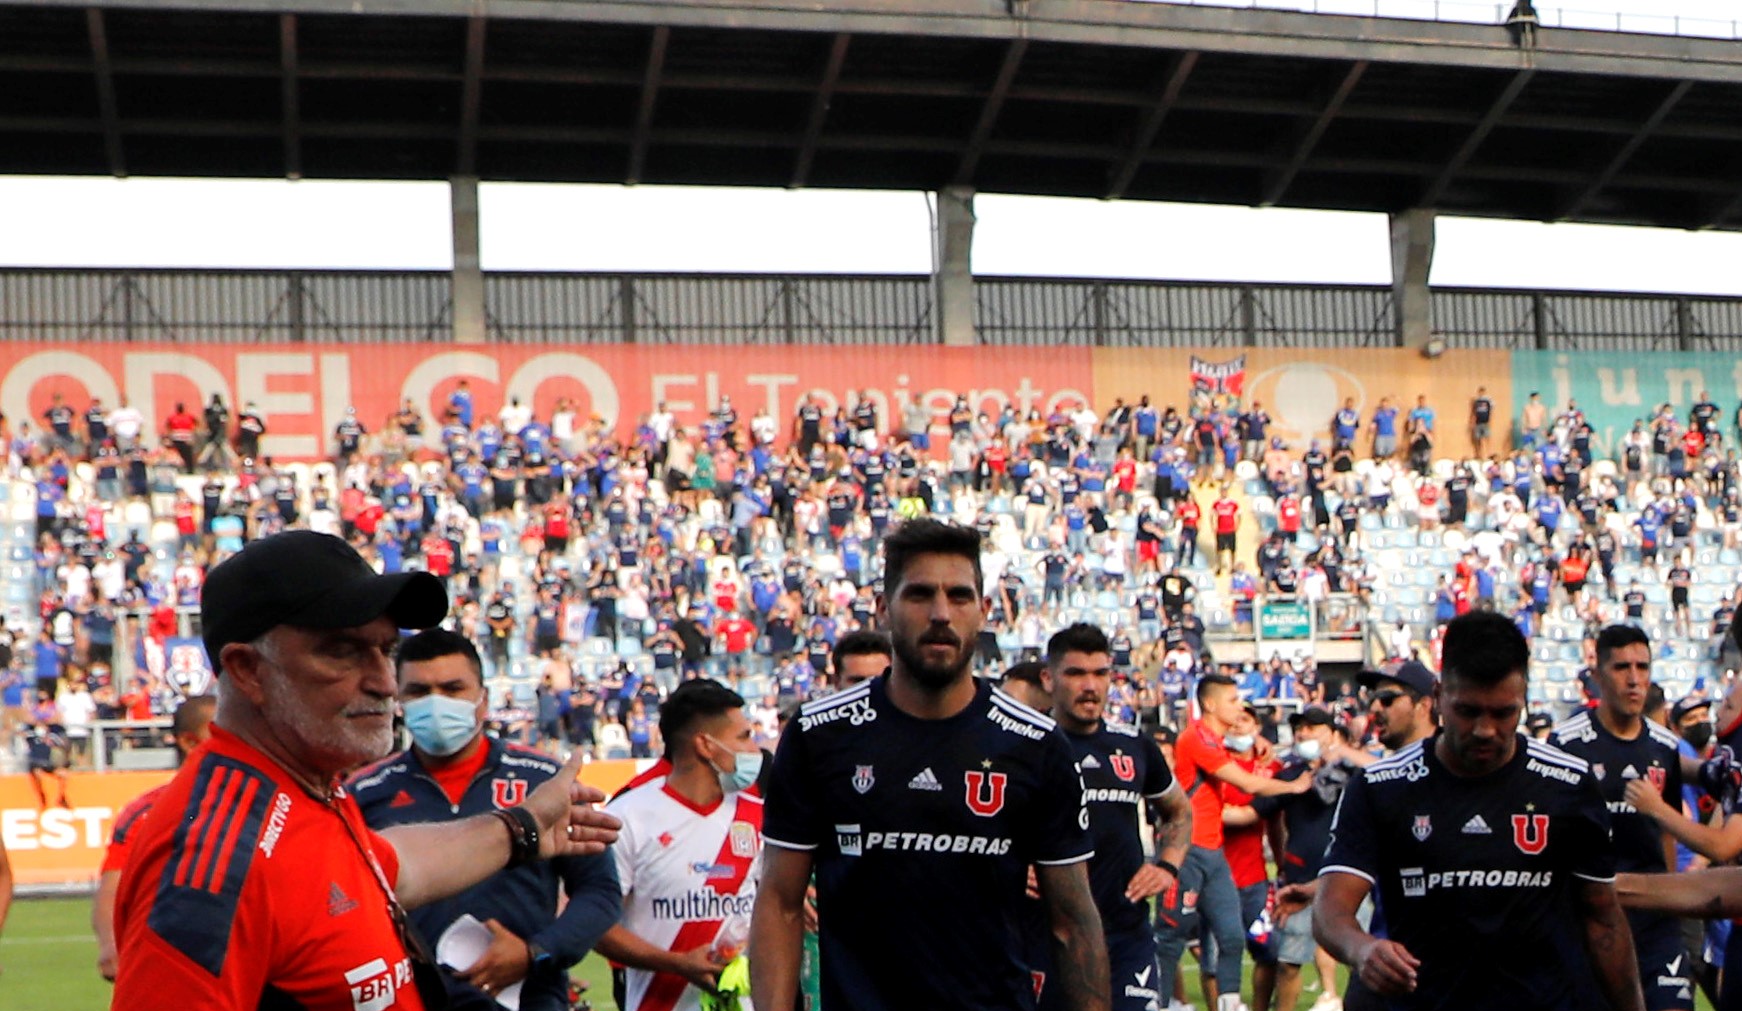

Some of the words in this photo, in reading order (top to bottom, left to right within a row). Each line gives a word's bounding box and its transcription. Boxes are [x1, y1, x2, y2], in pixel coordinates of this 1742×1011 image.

[797, 697, 870, 732] DIRECTV
[850, 708, 877, 725] GO
[491, 777, 528, 808] U
[964, 770, 1007, 818] U
[2, 806, 113, 850] EST
[865, 832, 1012, 855] PETROBRAS
[1511, 814, 1549, 855] U
[1428, 869, 1553, 889] PETROBRAS
